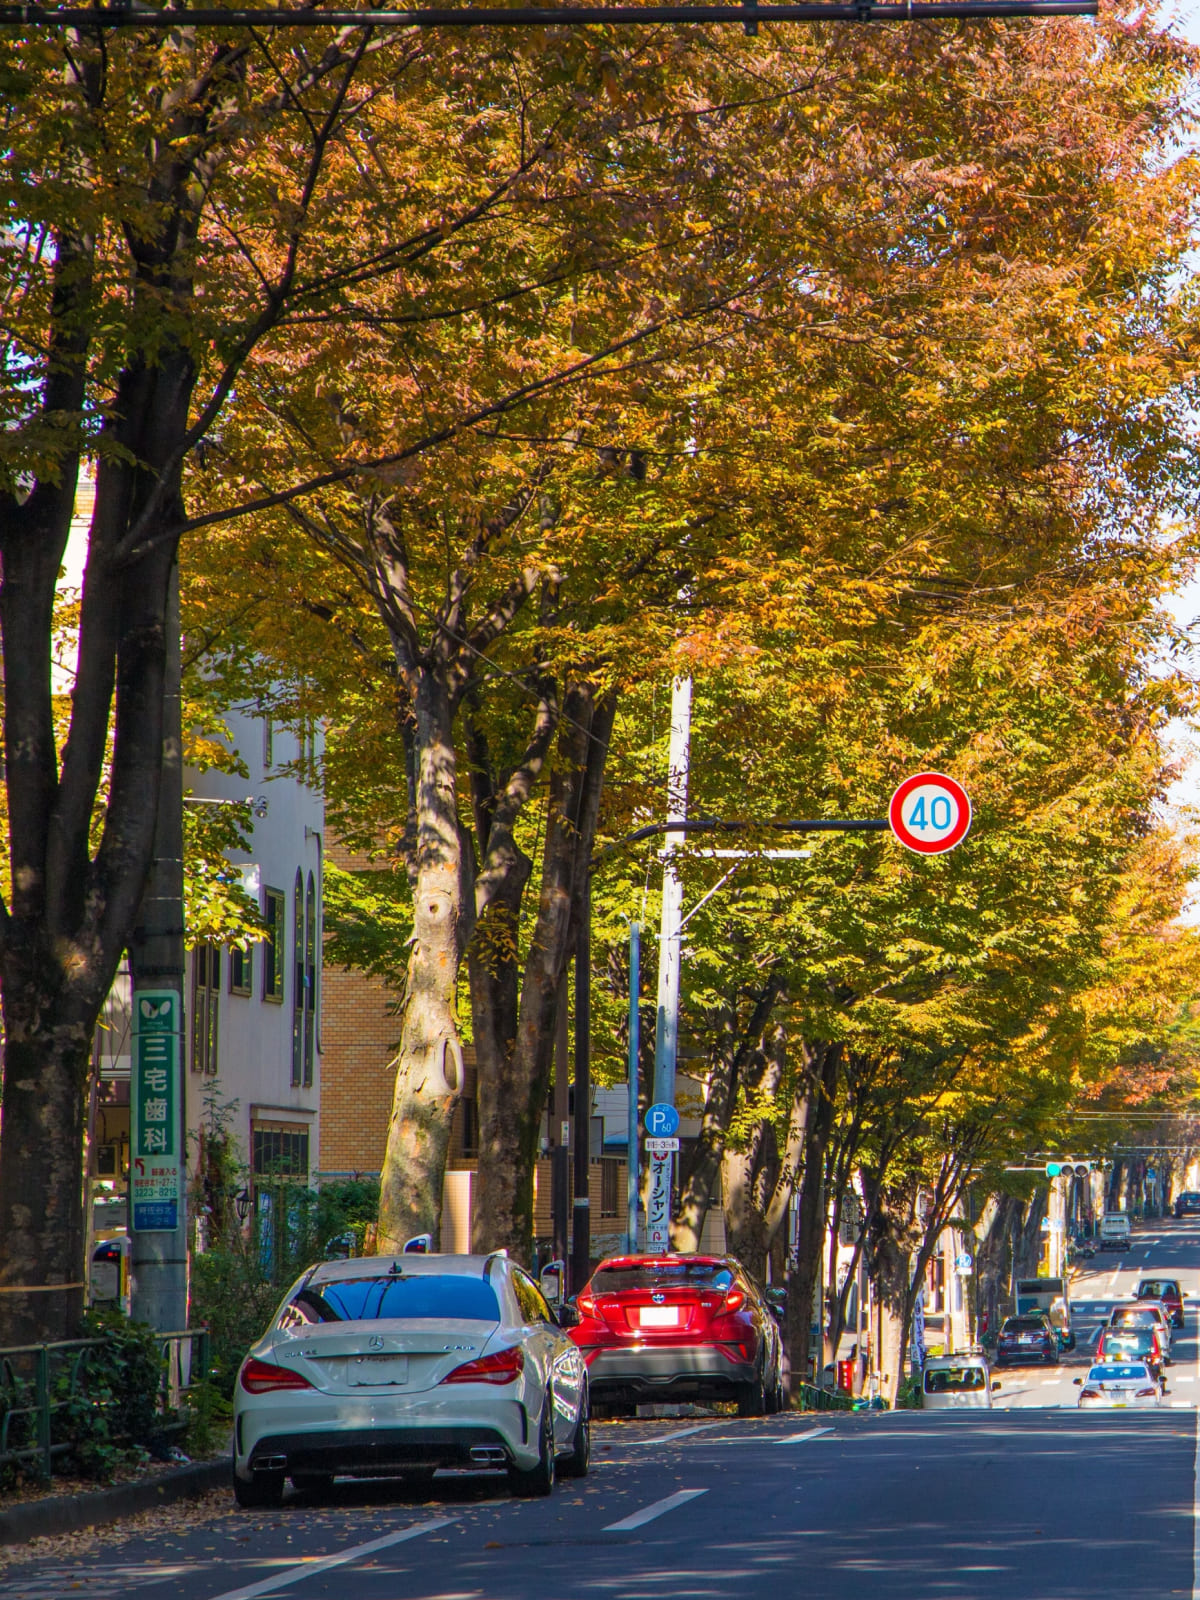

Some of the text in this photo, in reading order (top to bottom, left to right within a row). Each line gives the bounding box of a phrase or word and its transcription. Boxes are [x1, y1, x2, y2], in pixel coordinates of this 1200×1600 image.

[909, 796, 951, 830] 40
[144, 1038, 167, 1152] 三宅歯科
[652, 1111, 672, 1133] P 60
[134, 1188, 177, 1198] 3223-8215
[652, 1162, 665, 1222] オーシャン
